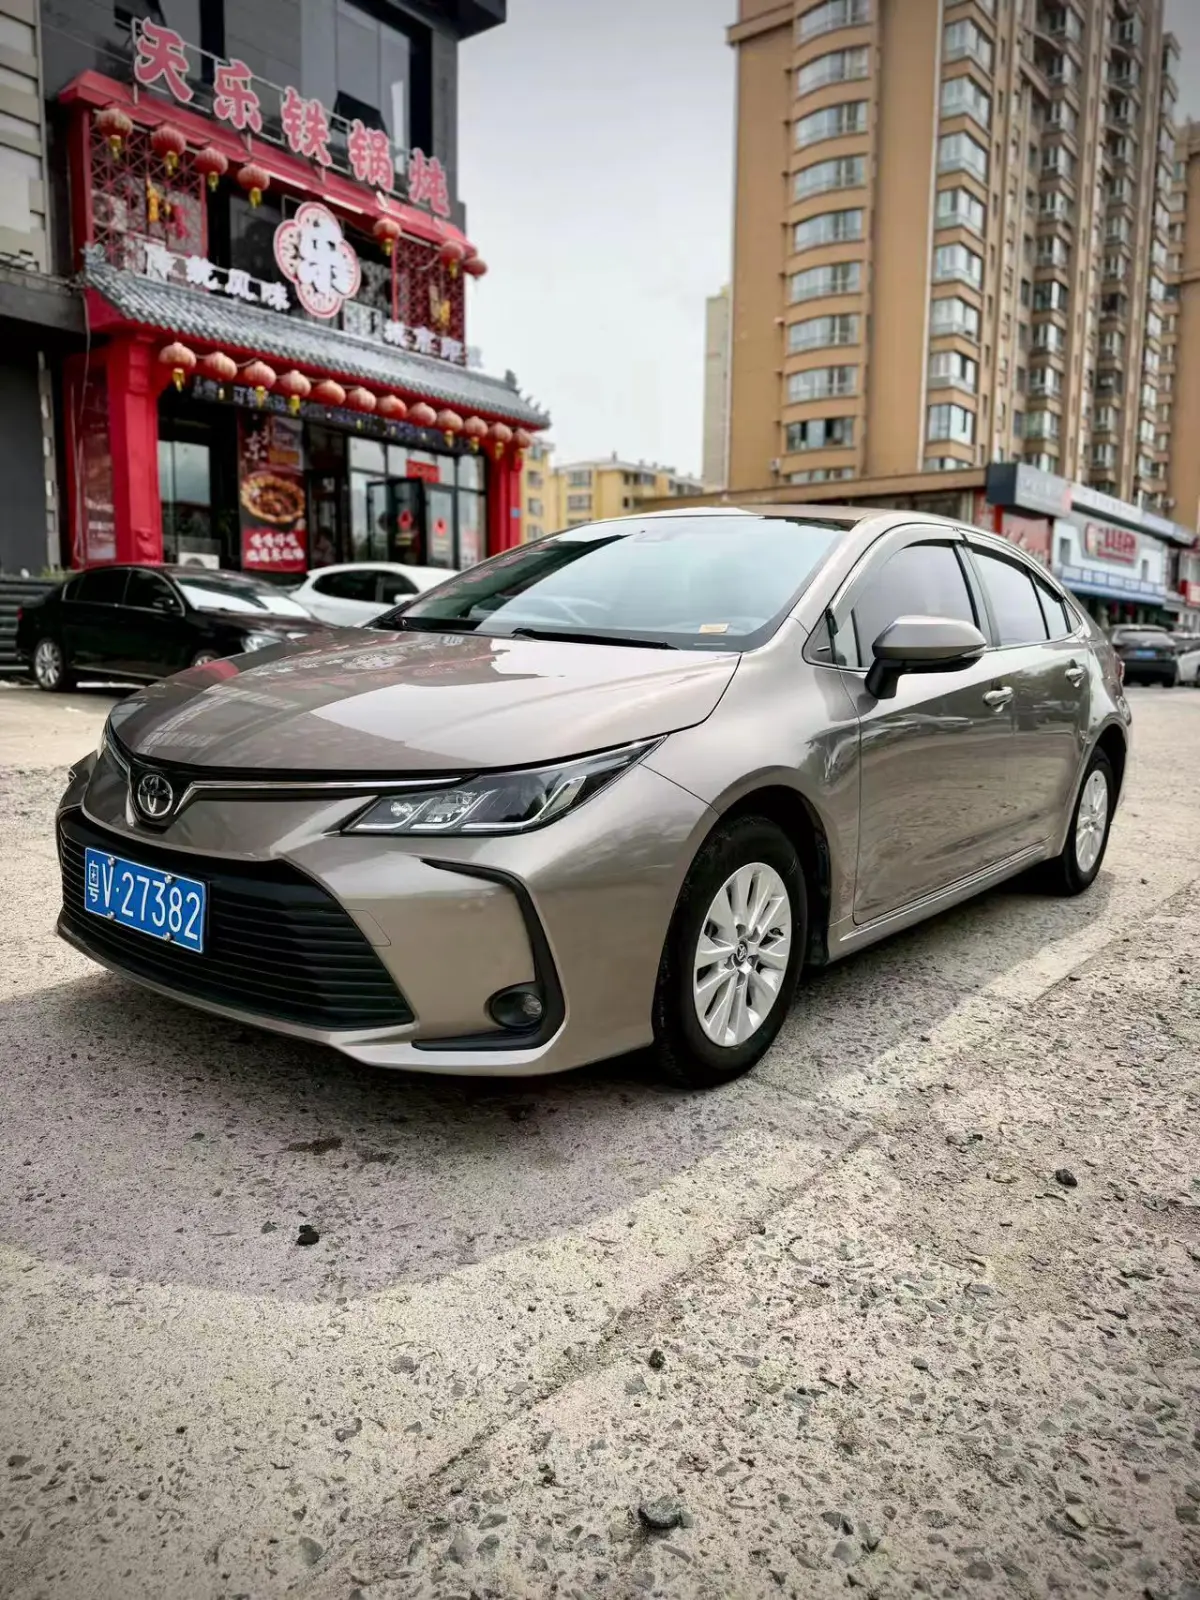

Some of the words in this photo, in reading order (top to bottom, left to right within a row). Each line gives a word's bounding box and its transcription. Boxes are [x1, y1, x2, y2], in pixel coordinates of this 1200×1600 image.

[134, 17, 450, 217] 天乐铁锅炖
